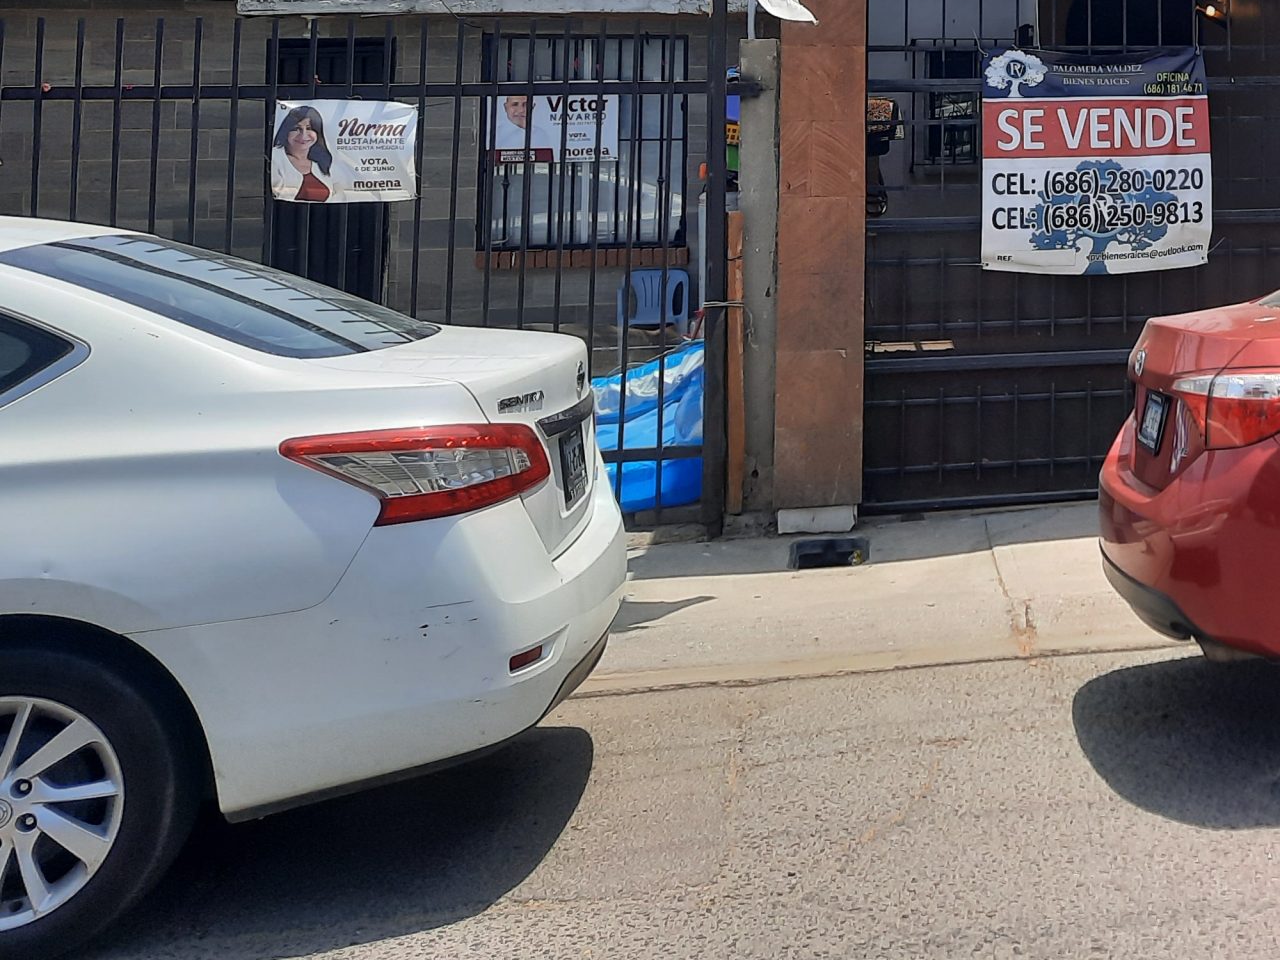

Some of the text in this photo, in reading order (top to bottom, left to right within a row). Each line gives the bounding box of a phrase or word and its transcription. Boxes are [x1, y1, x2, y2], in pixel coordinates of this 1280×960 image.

[1052, 64, 1143, 74] PALOMERA VALDEZ
[1063, 77, 1130, 86] BIENES RAICES
[1156, 72, 1190, 82] OFICINA
[1143, 83, 1165, 95] (686)
[546, 95, 609, 113] Vctor
[338, 117, 407, 137] Norma
[996, 106, 1197, 151] SE VENDE
[336, 137, 406, 145] BUSTAMANTE
[562, 147, 611, 157] orea
[360, 158, 389, 166] VOTA
[353, 179, 402, 189] morena
[991, 168, 1204, 200] CEL: (686) 280-0220
[991, 201, 1204, 234] CEL: (686) 250-9813
